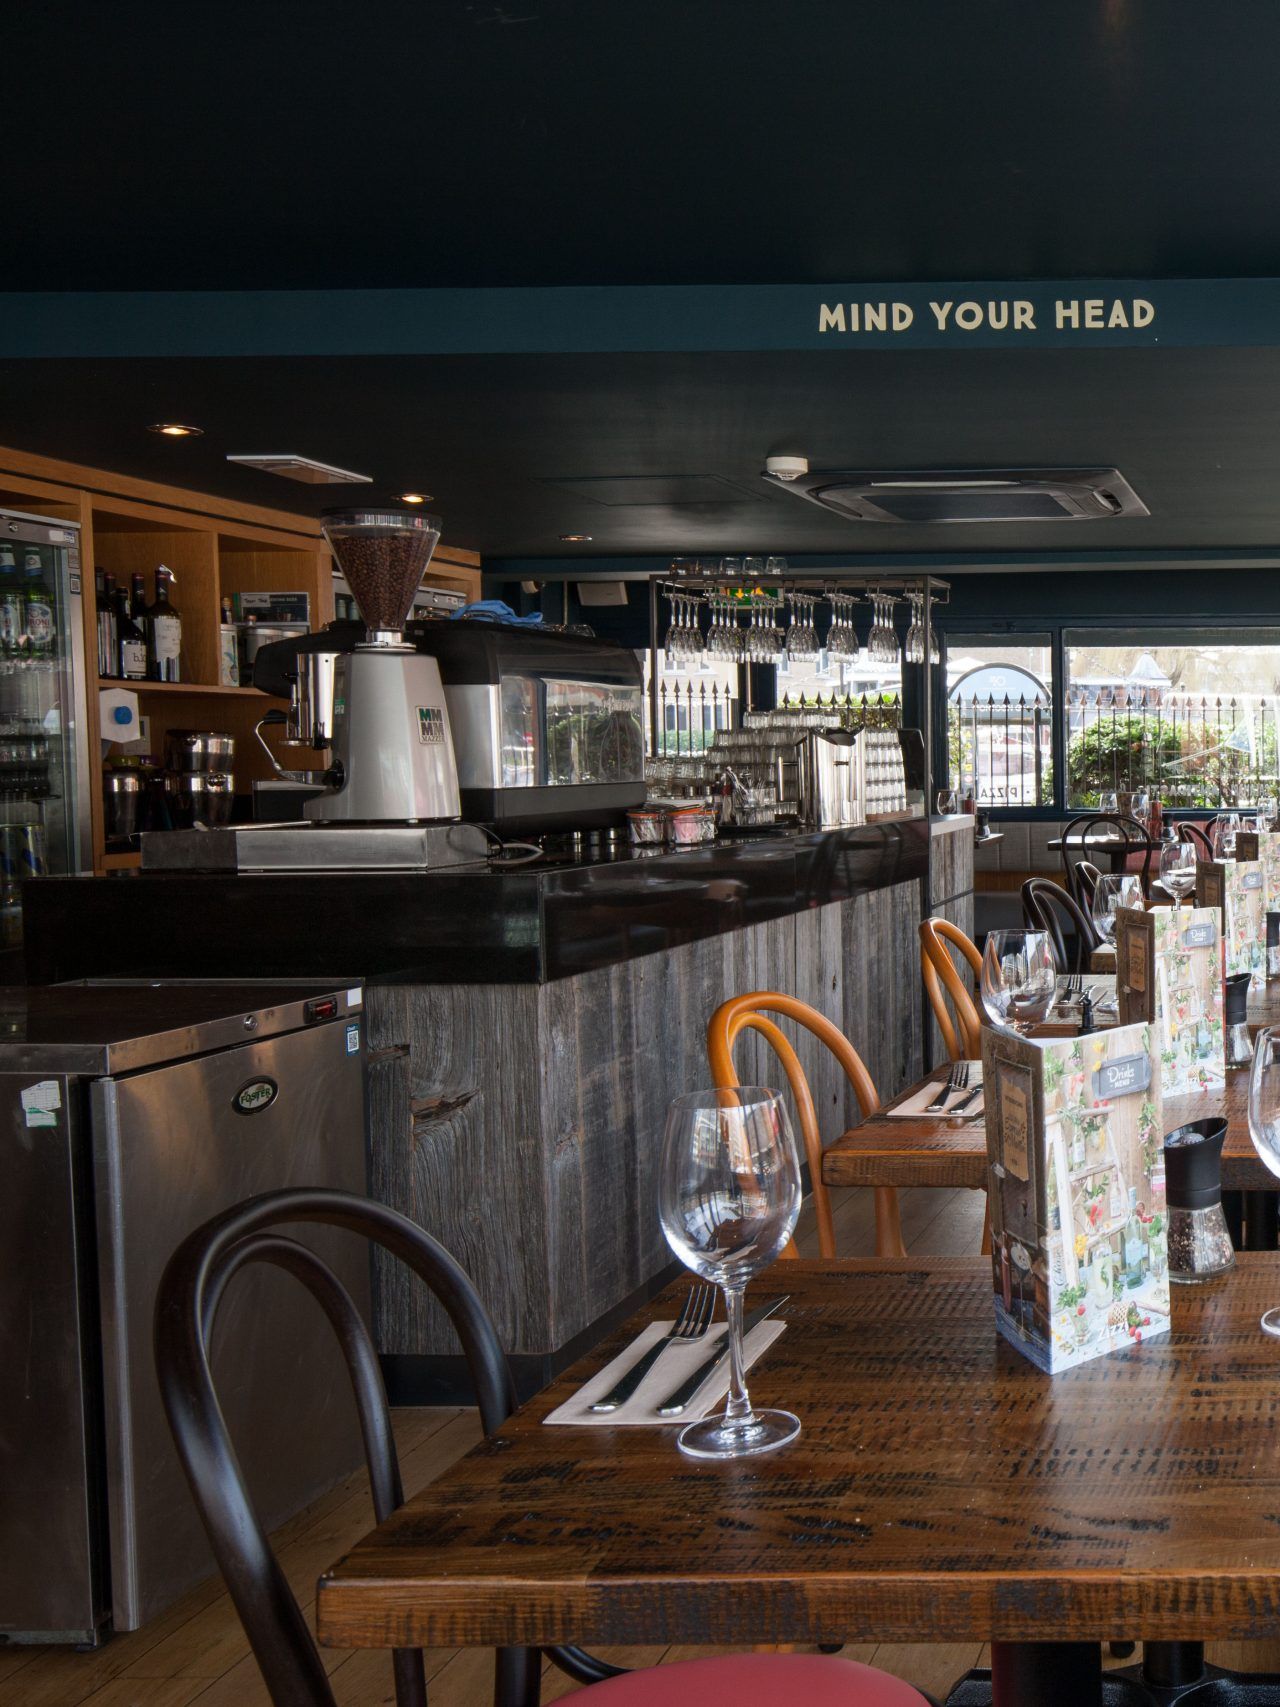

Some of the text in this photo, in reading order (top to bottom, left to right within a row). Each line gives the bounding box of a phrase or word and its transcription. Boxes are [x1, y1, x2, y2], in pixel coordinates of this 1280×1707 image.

[819, 300, 1155, 332] MIND YOUR HEAD
[1107, 1063, 1135, 1083] Drinks
[240, 1087, 271, 1105] FOSTER
